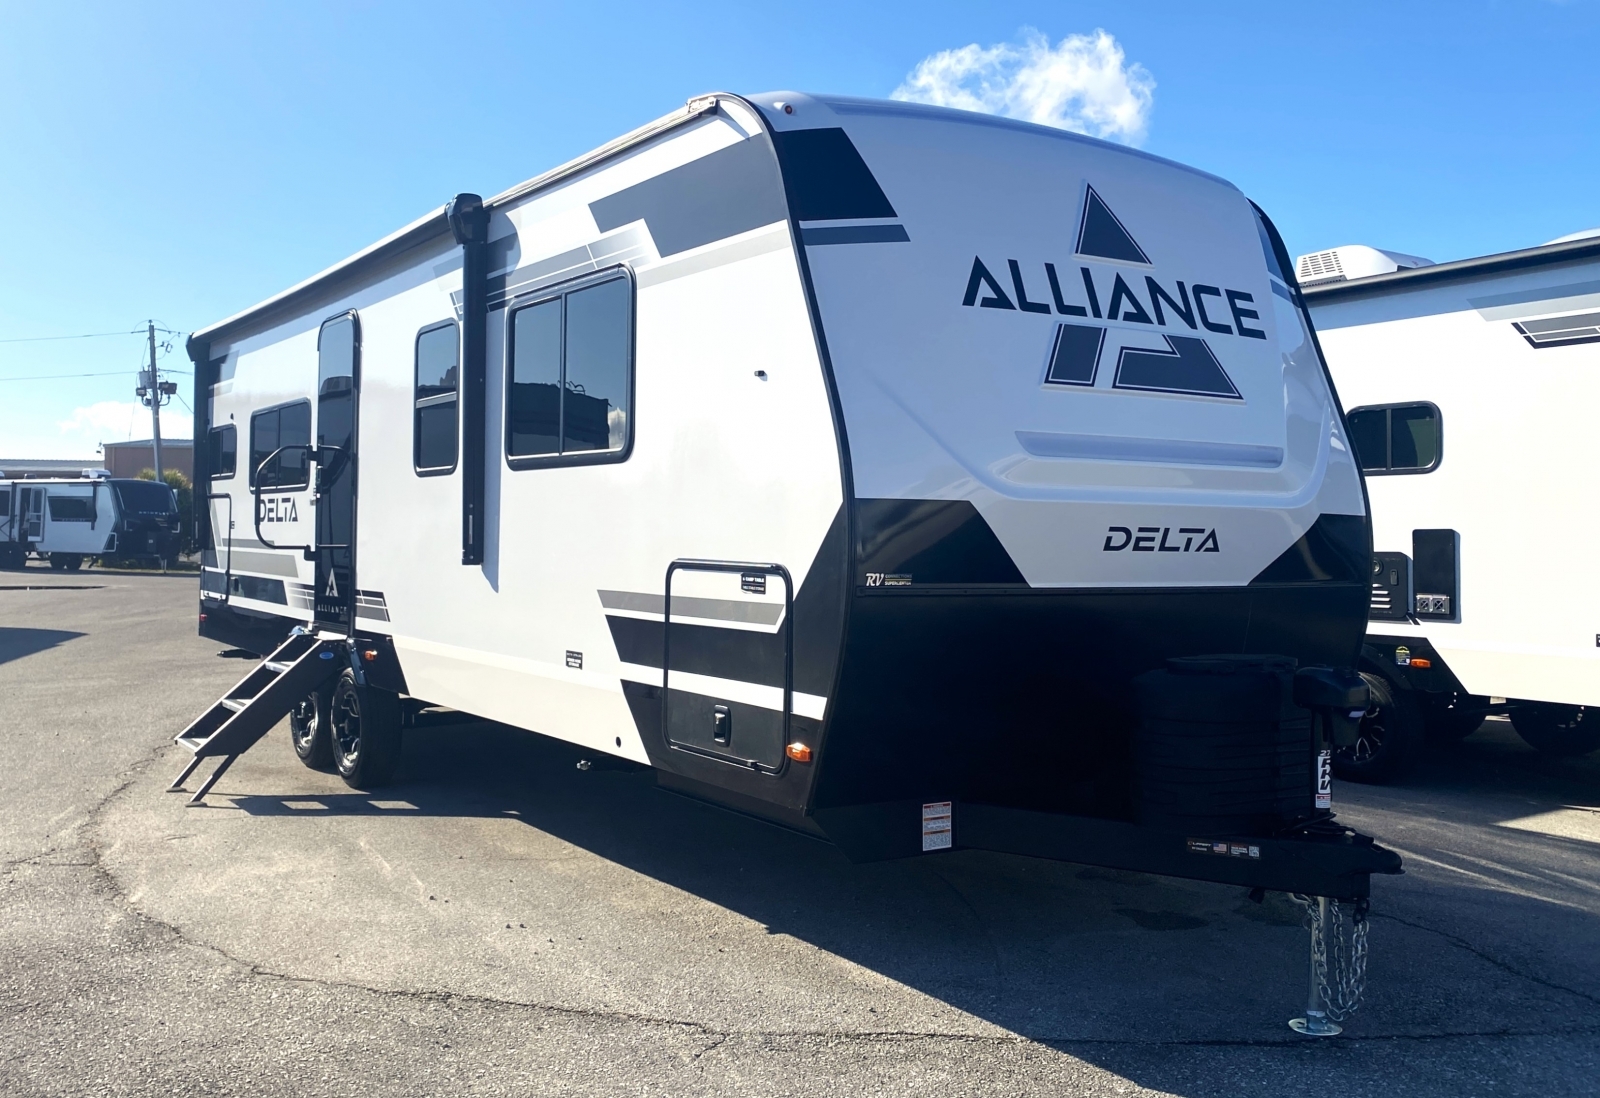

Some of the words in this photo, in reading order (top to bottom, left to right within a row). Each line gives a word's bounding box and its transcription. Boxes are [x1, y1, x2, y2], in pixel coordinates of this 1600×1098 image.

[962, 255, 1267, 340] ALLIANCE
[260, 497, 298, 522] DELTA
[1103, 526, 1220, 552] DELTA
[866, 573, 884, 586] RV
[317, 604, 347, 614] ALLIANCE
